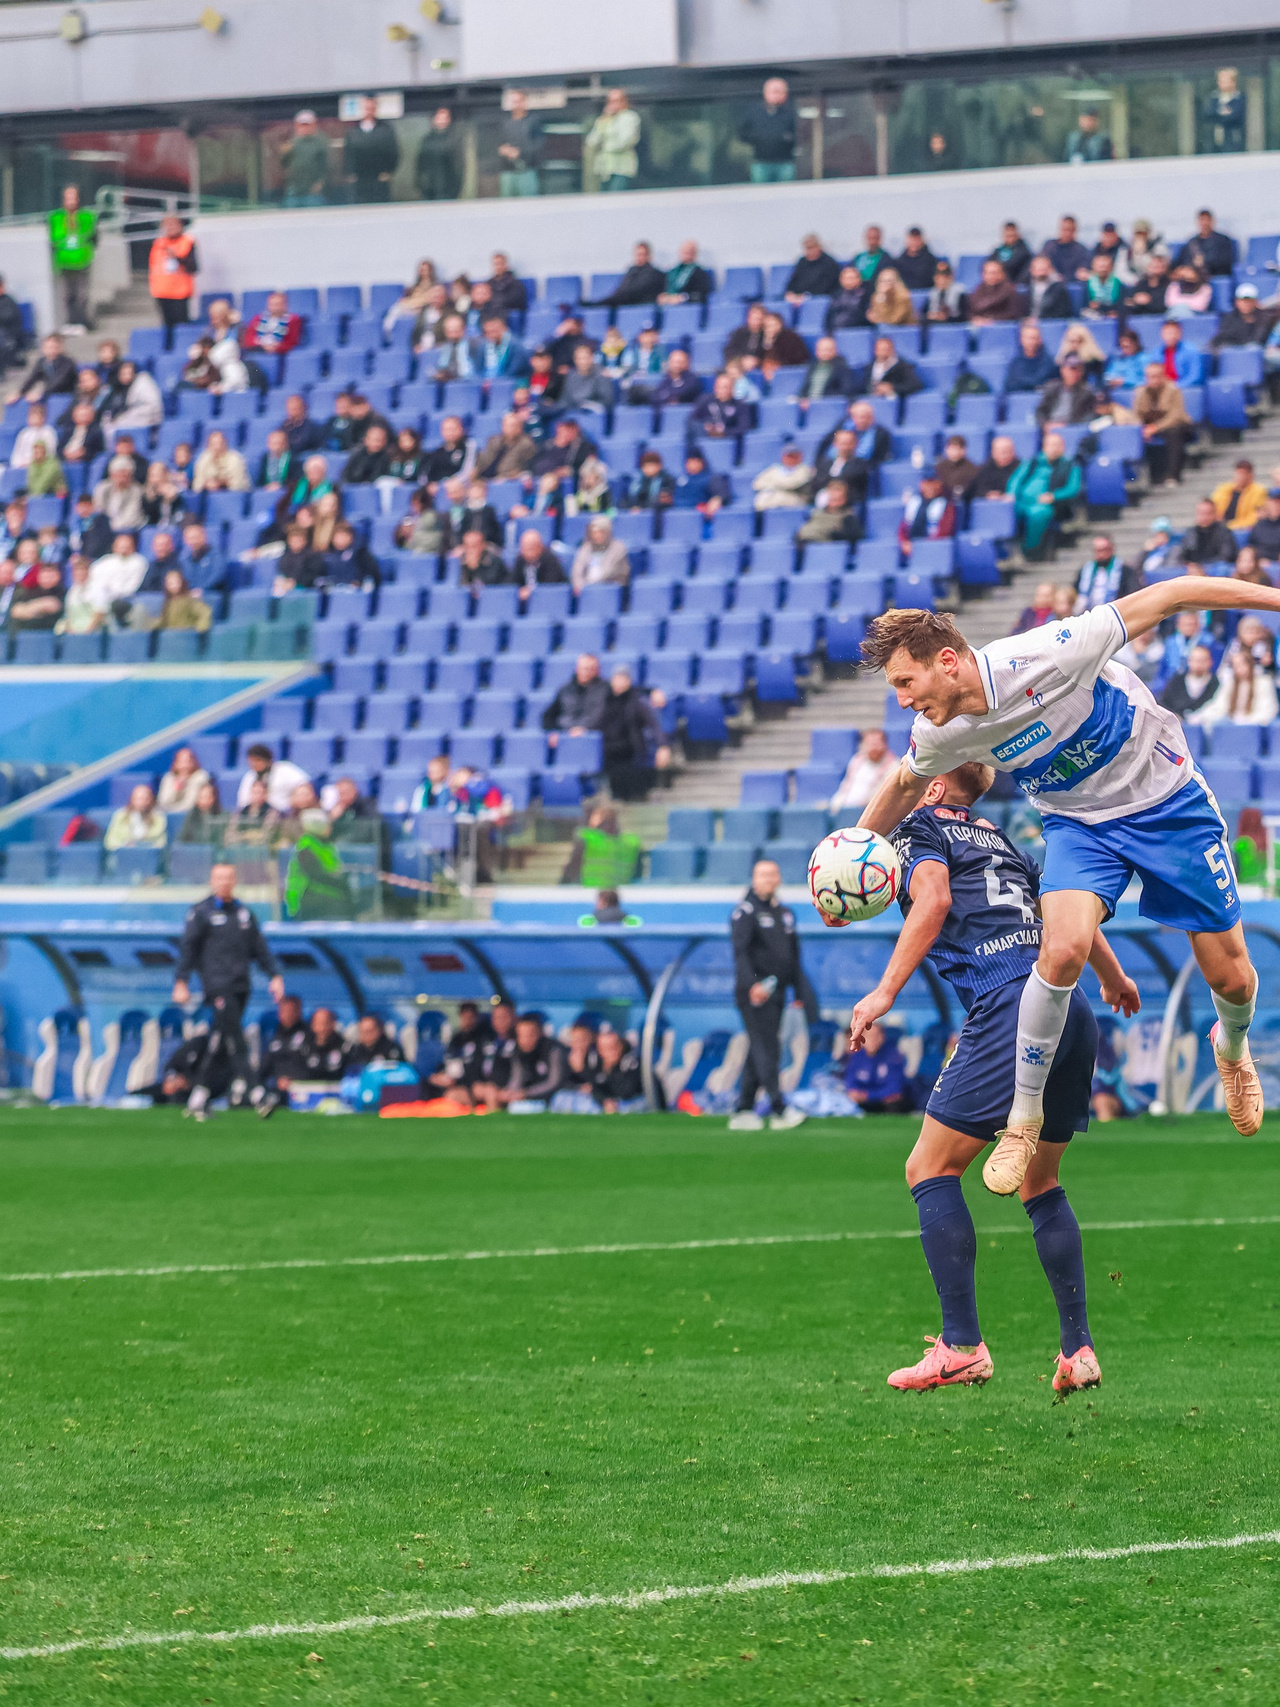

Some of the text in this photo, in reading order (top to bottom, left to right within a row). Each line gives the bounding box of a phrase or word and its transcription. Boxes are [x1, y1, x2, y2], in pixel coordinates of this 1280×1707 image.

[996, 724, 1047, 759] БЕТСИТИ
[942, 825, 1011, 853] ГОРШКОВ
[1203, 843, 1231, 890] 5
[983, 854, 1034, 924] 4
[1021, 1056, 1045, 1066] KELME
